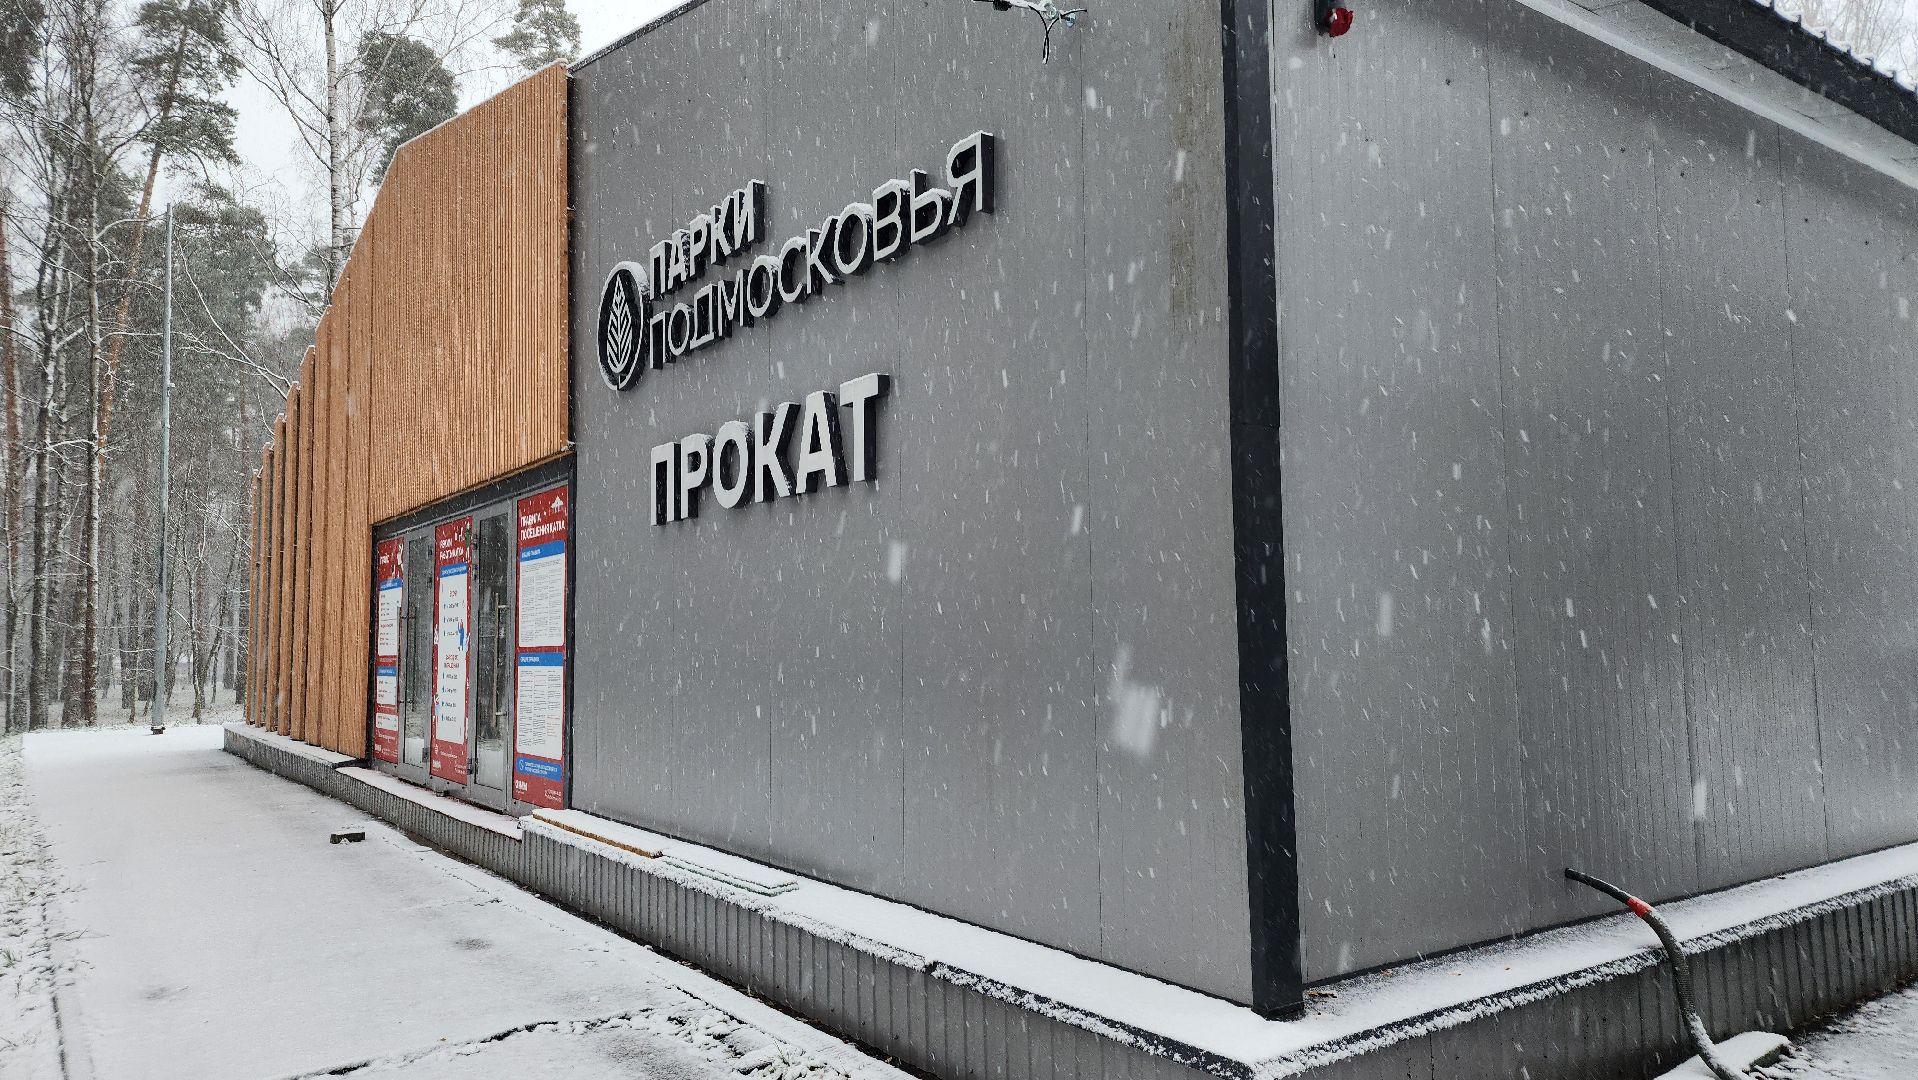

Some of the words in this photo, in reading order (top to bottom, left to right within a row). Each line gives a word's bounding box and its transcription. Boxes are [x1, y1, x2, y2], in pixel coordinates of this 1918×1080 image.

[649, 179, 765, 300] ПАРКИ
[649, 130, 994, 370] ПОДМОСКОВЬЯ
[650, 373, 890, 526] ПРОКАТ
